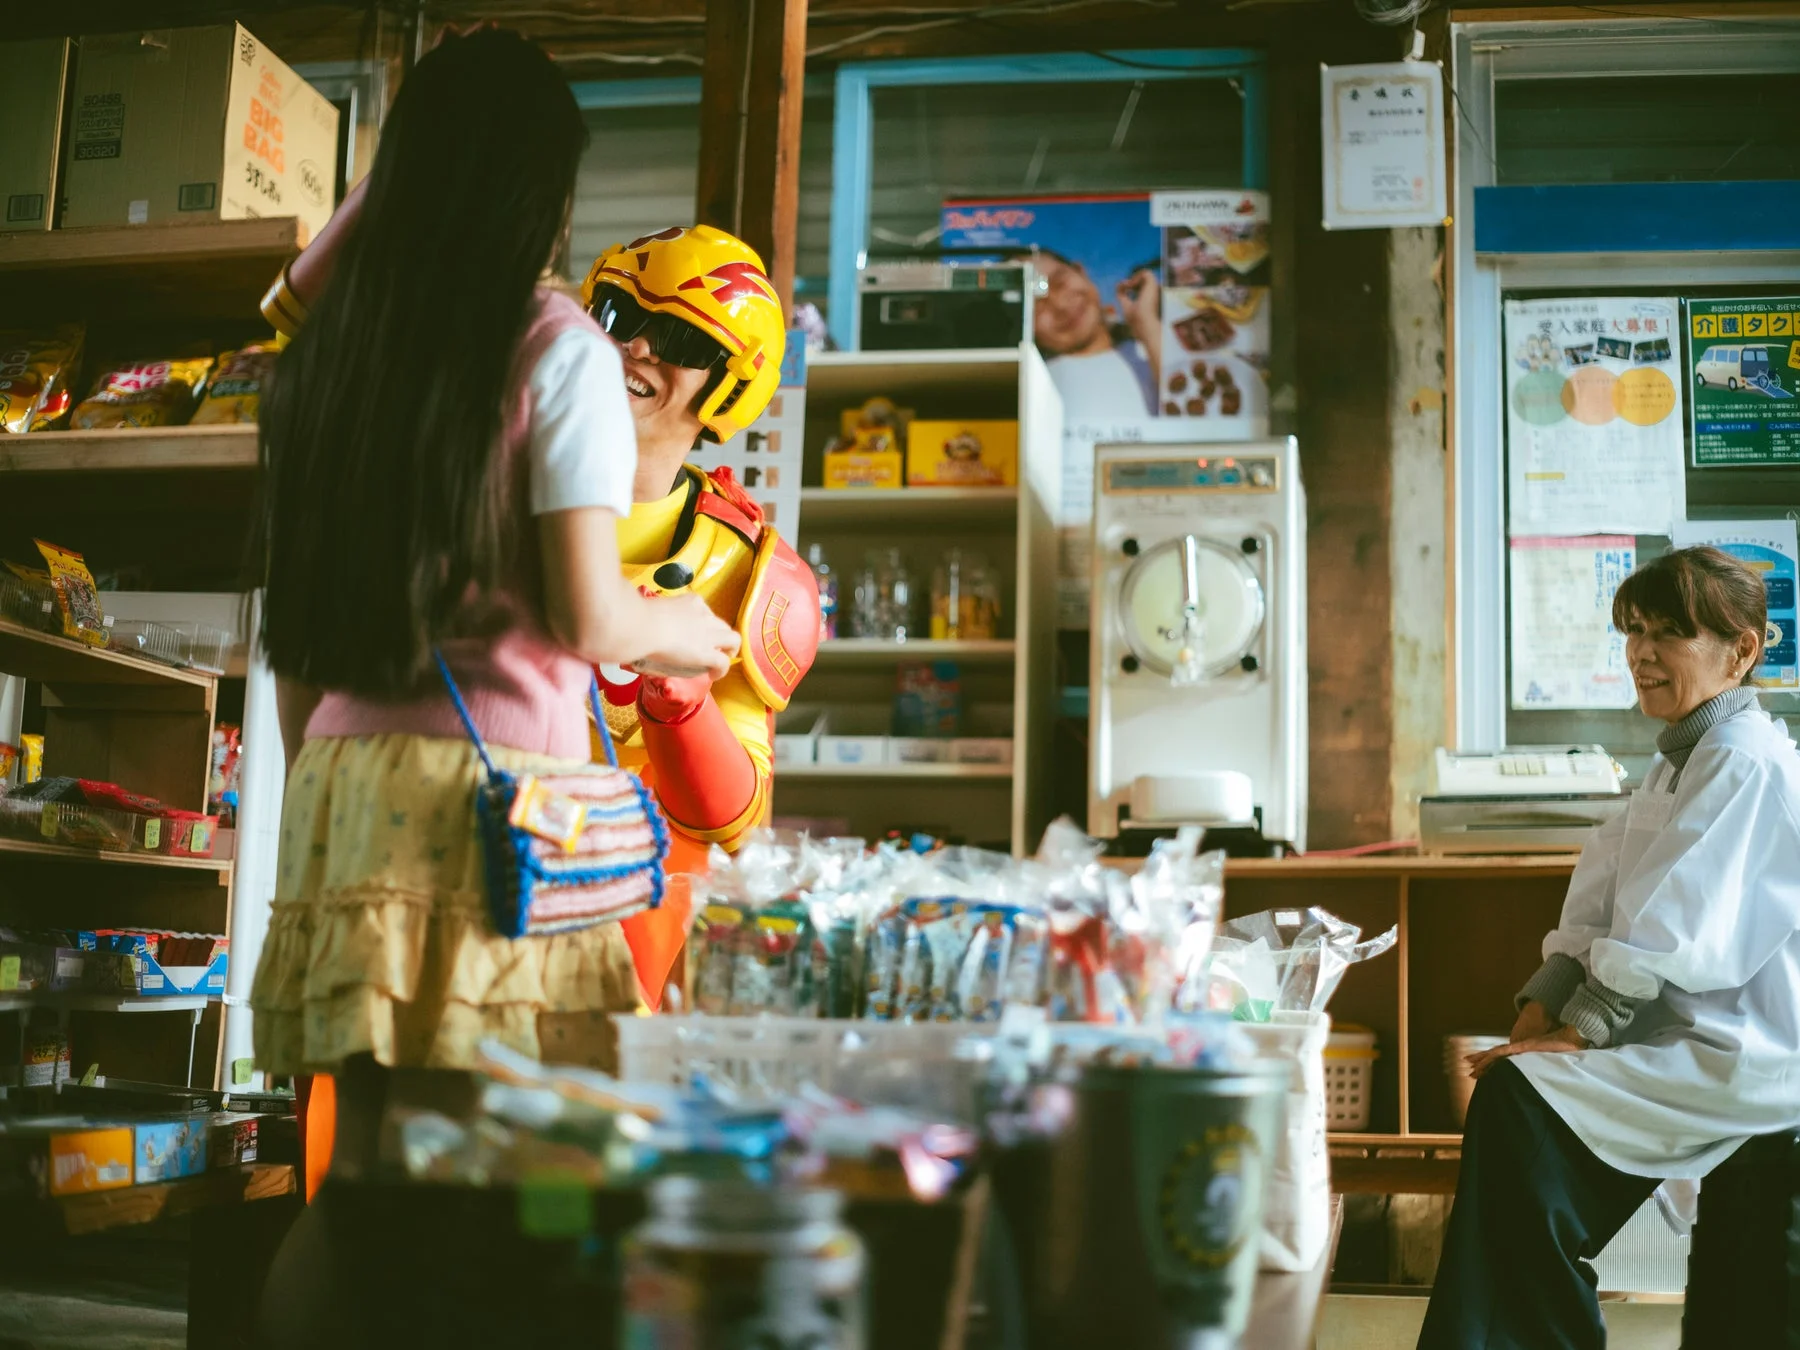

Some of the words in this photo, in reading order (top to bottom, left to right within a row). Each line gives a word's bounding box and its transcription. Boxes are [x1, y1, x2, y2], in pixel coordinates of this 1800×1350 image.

[249, 97, 284, 143] BIG
[244, 122, 285, 175] BAG
[1696, 315, 1800, 335] 介護タク
